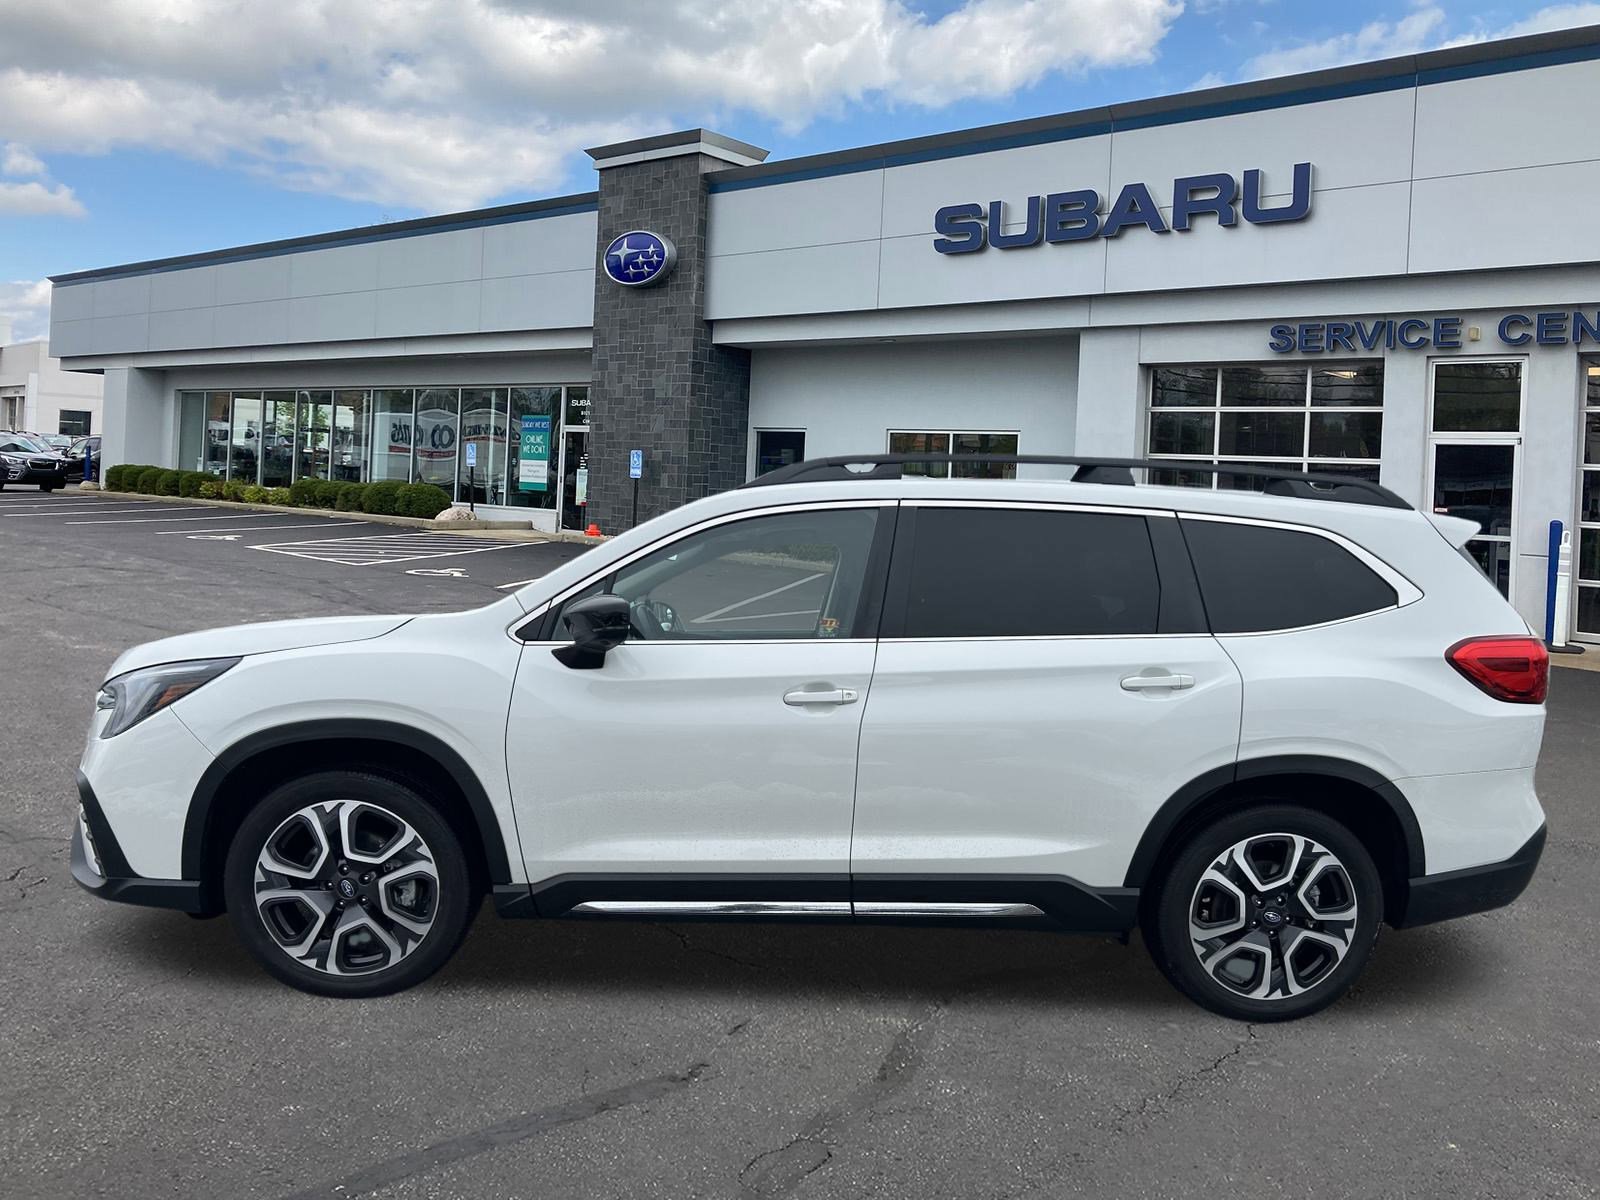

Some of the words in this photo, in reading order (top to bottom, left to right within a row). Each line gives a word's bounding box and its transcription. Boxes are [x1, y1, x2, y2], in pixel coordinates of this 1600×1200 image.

[934, 162, 1313, 255] SUBARU
[1269, 318, 1463, 353] SERVICE
[1498, 311, 1600, 346] CEN
[571, 399, 591, 407] SUBA
